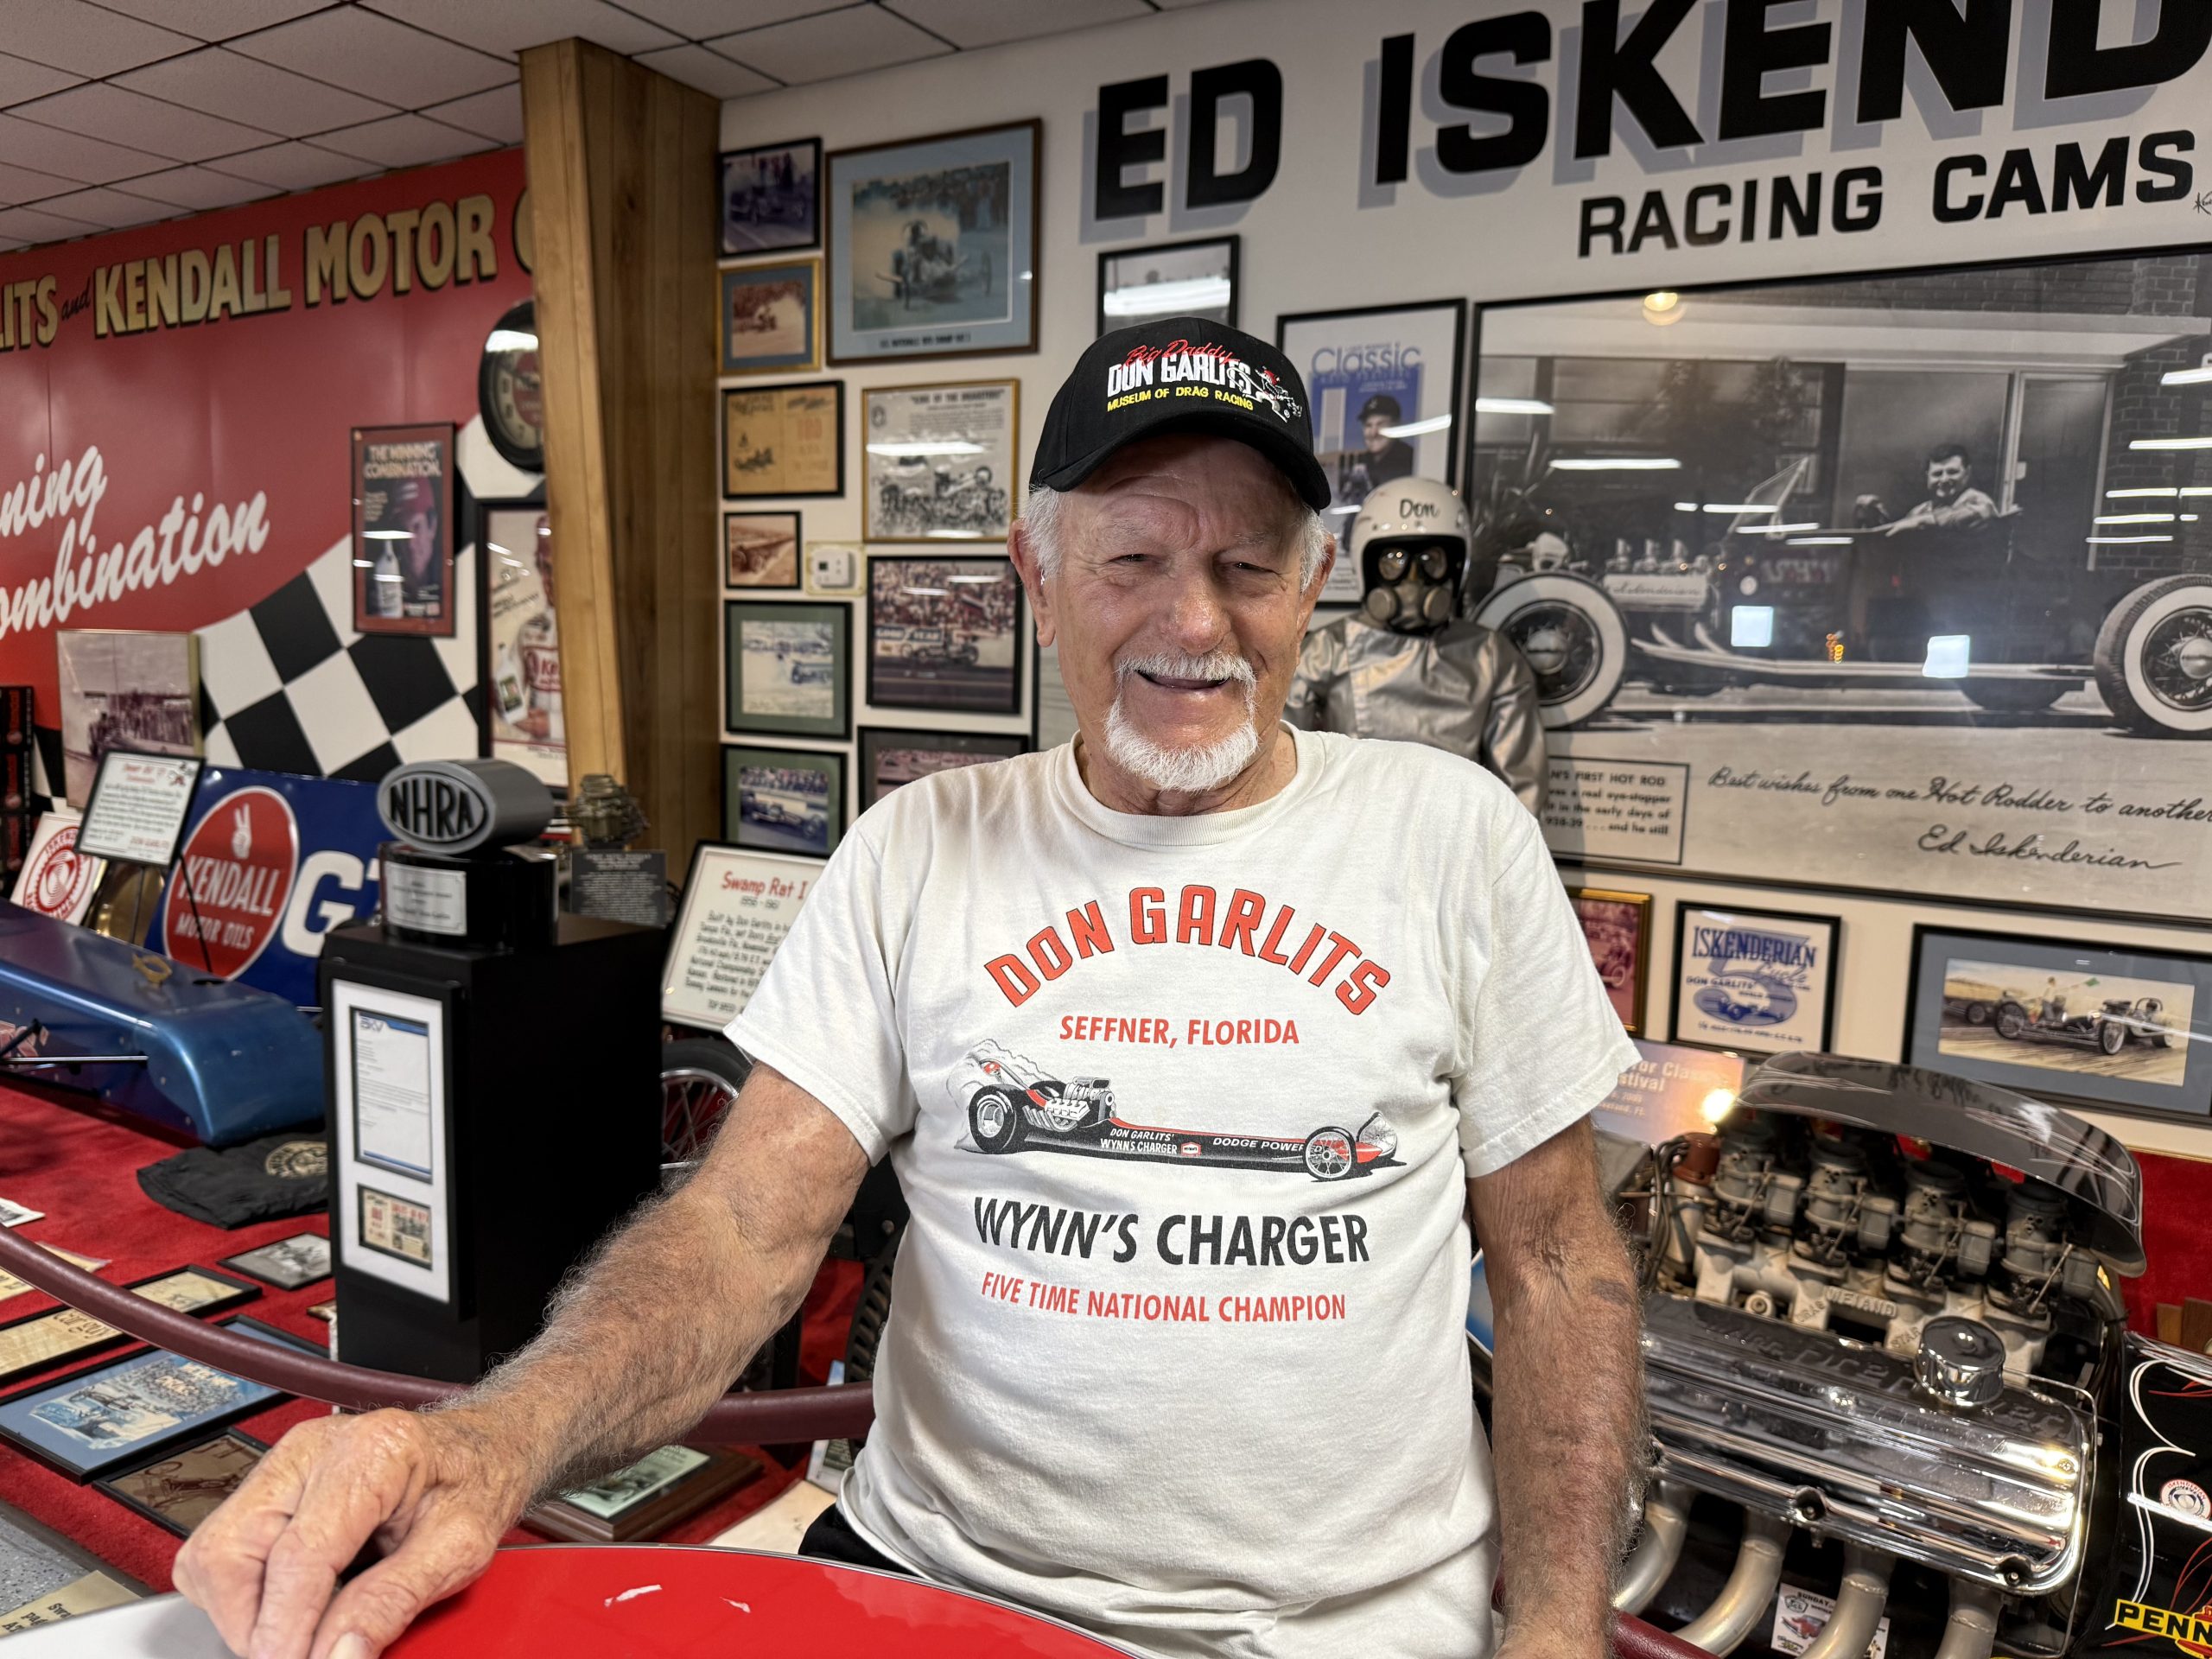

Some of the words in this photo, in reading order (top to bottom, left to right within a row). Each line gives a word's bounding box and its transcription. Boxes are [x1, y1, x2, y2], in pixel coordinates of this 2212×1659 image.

[1095, 57, 1284, 222] ED
[1578, 166, 1883, 258] RACING
[1932, 130, 2196, 224] CAMS
[61, 275, 92, 321] and
[94, 232, 292, 339] KENDALL
[304, 194, 498, 309] MOTOR
[1121, 344, 1162, 369] Big
[1161, 339, 1241, 366] Daddy
[1312, 343, 1421, 375] Classic
[1108, 356, 1154, 397] DON
[1160, 352, 1252, 395] GARLITS
[1107, 390, 1152, 412] MUSEUM
[1154, 388, 1170, 398] OF
[1175, 386, 1209, 397] DRAG
[1214, 390, 1254, 411] RACING
[1399, 498, 1439, 518] Don
[1575, 771, 1605, 781] FIRST
[1610, 773, 1634, 783] HOT
[1640, 775, 1665, 785] ROD
[1707, 766, 1758, 787] Best
[1758, 771, 1822, 794] wishes
[1821, 775, 1881, 806] from
[1885, 787, 1919, 800] one
[1920, 777, 1982, 805] Hot
[1981, 782, 2075, 813] Rodder
[2079, 791, 2113, 814] to
[389, 779, 474, 839] NHRA
[1581, 790, 1602, 798] real
[1607, 793, 1671, 804] eye-stopper
[1595, 806, 1621, 817] early
[1627, 808, 1653, 818] days
[1658, 810, 1670, 819] of
[1609, 823, 1629, 832] and
[1632, 824, 1646, 834] he
[1649, 824, 1669, 836] still
[1917, 823, 1967, 855] Ed
[1968, 831, 2184, 870] Iskenderian
[178, 855, 280, 918] KENDALL
[721, 870, 766, 897] Swamp
[768, 876, 795, 898] Rat
[175, 912, 222, 943] MOTOR
[221, 921, 255, 950] OILS
[1692, 926, 1816, 968] ISKENDERIAN
[984, 899, 1116, 1008] DON
[1128, 884, 1391, 1016] GARLITS
[1686, 975, 1708, 986] DON
[1059, 1015, 1178, 1049] SEFFNER,
[1187, 1018, 1300, 1046] FLORIDA
[1100, 1138, 1135, 1153] WYNN'S
[1137, 1141, 1178, 1155] CHARGER
[1110, 1128, 1129, 1139] DON
[1130, 1130, 1175, 1141] GARLITS'
[1212, 1137, 1259, 1148] DODGE
[974, 1196, 1140, 1264] WYNN'S
[1156, 1214, 1370, 1267] CHARGER
[982, 1272, 1021, 1305] FIVE
[1029, 1281, 1078, 1315] TIME
[1086, 1289, 1211, 1324] NATIONAL
[1218, 1294, 1346, 1323] CHAMPION
[48, 1602, 76, 1619] Swa
[1797, 1592, 1830, 1607] SUNDAY
